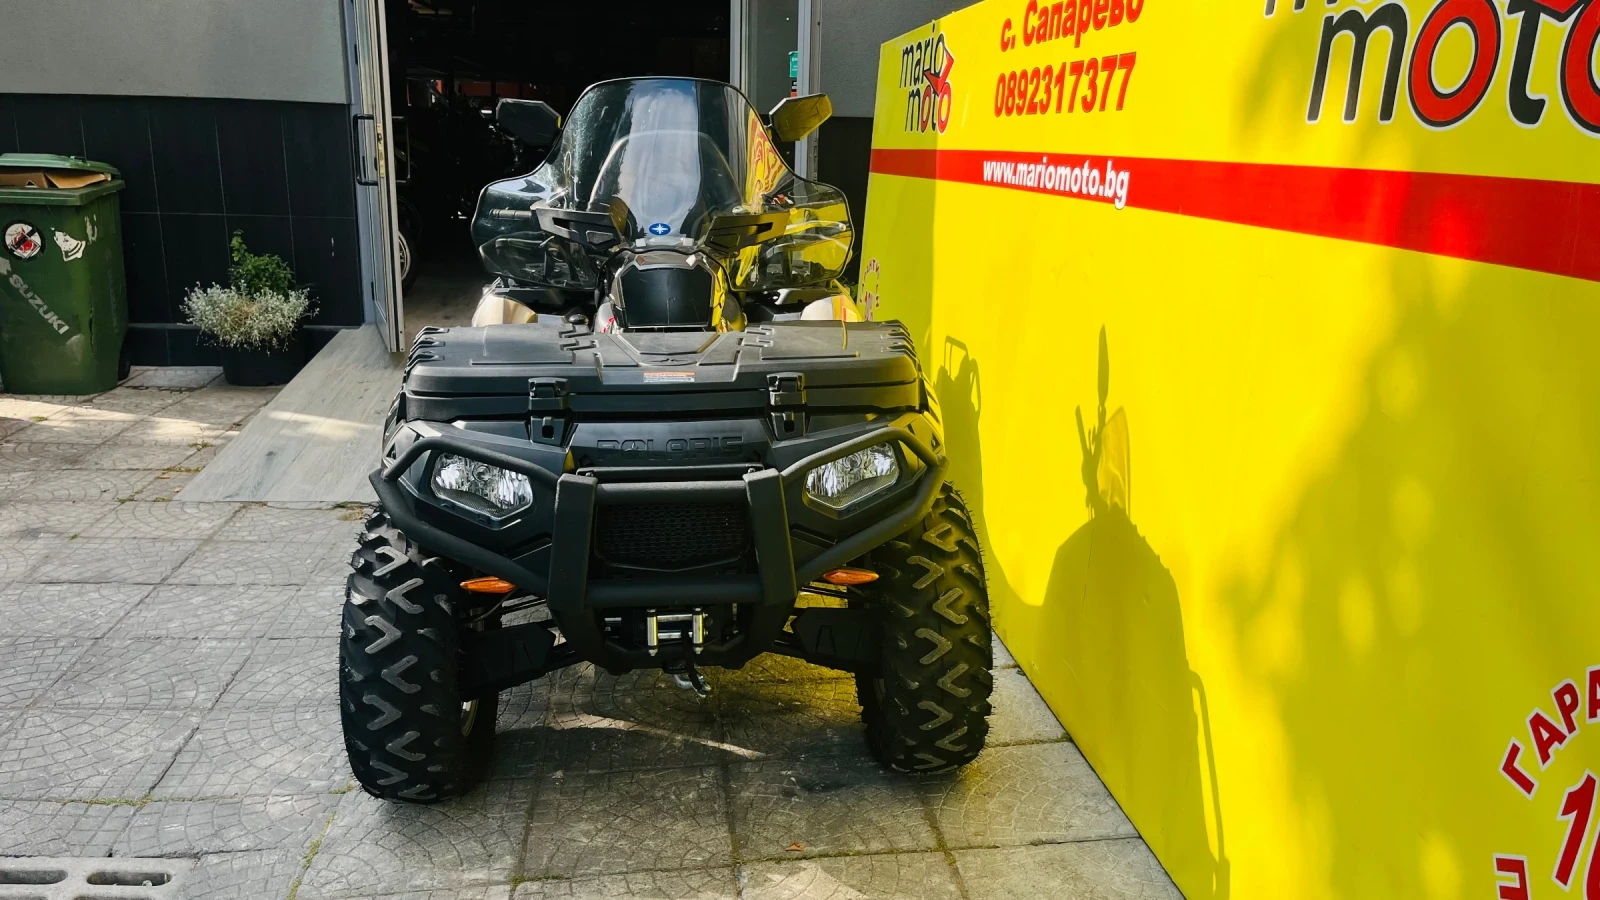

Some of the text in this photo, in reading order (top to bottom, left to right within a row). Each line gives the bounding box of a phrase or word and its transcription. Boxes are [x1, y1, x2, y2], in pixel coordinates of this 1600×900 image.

[1023, 0, 1145, 48] Сапарево
[899, 22, 945, 88] mario
[904, 82, 952, 133] moto
[994, 52, 1137, 117] 0892317377
[983, 156, 1130, 210] www.mariomoto.bg
[9, 273, 70, 335] SUZUKI
[597, 436, 744, 460] POLARIS
